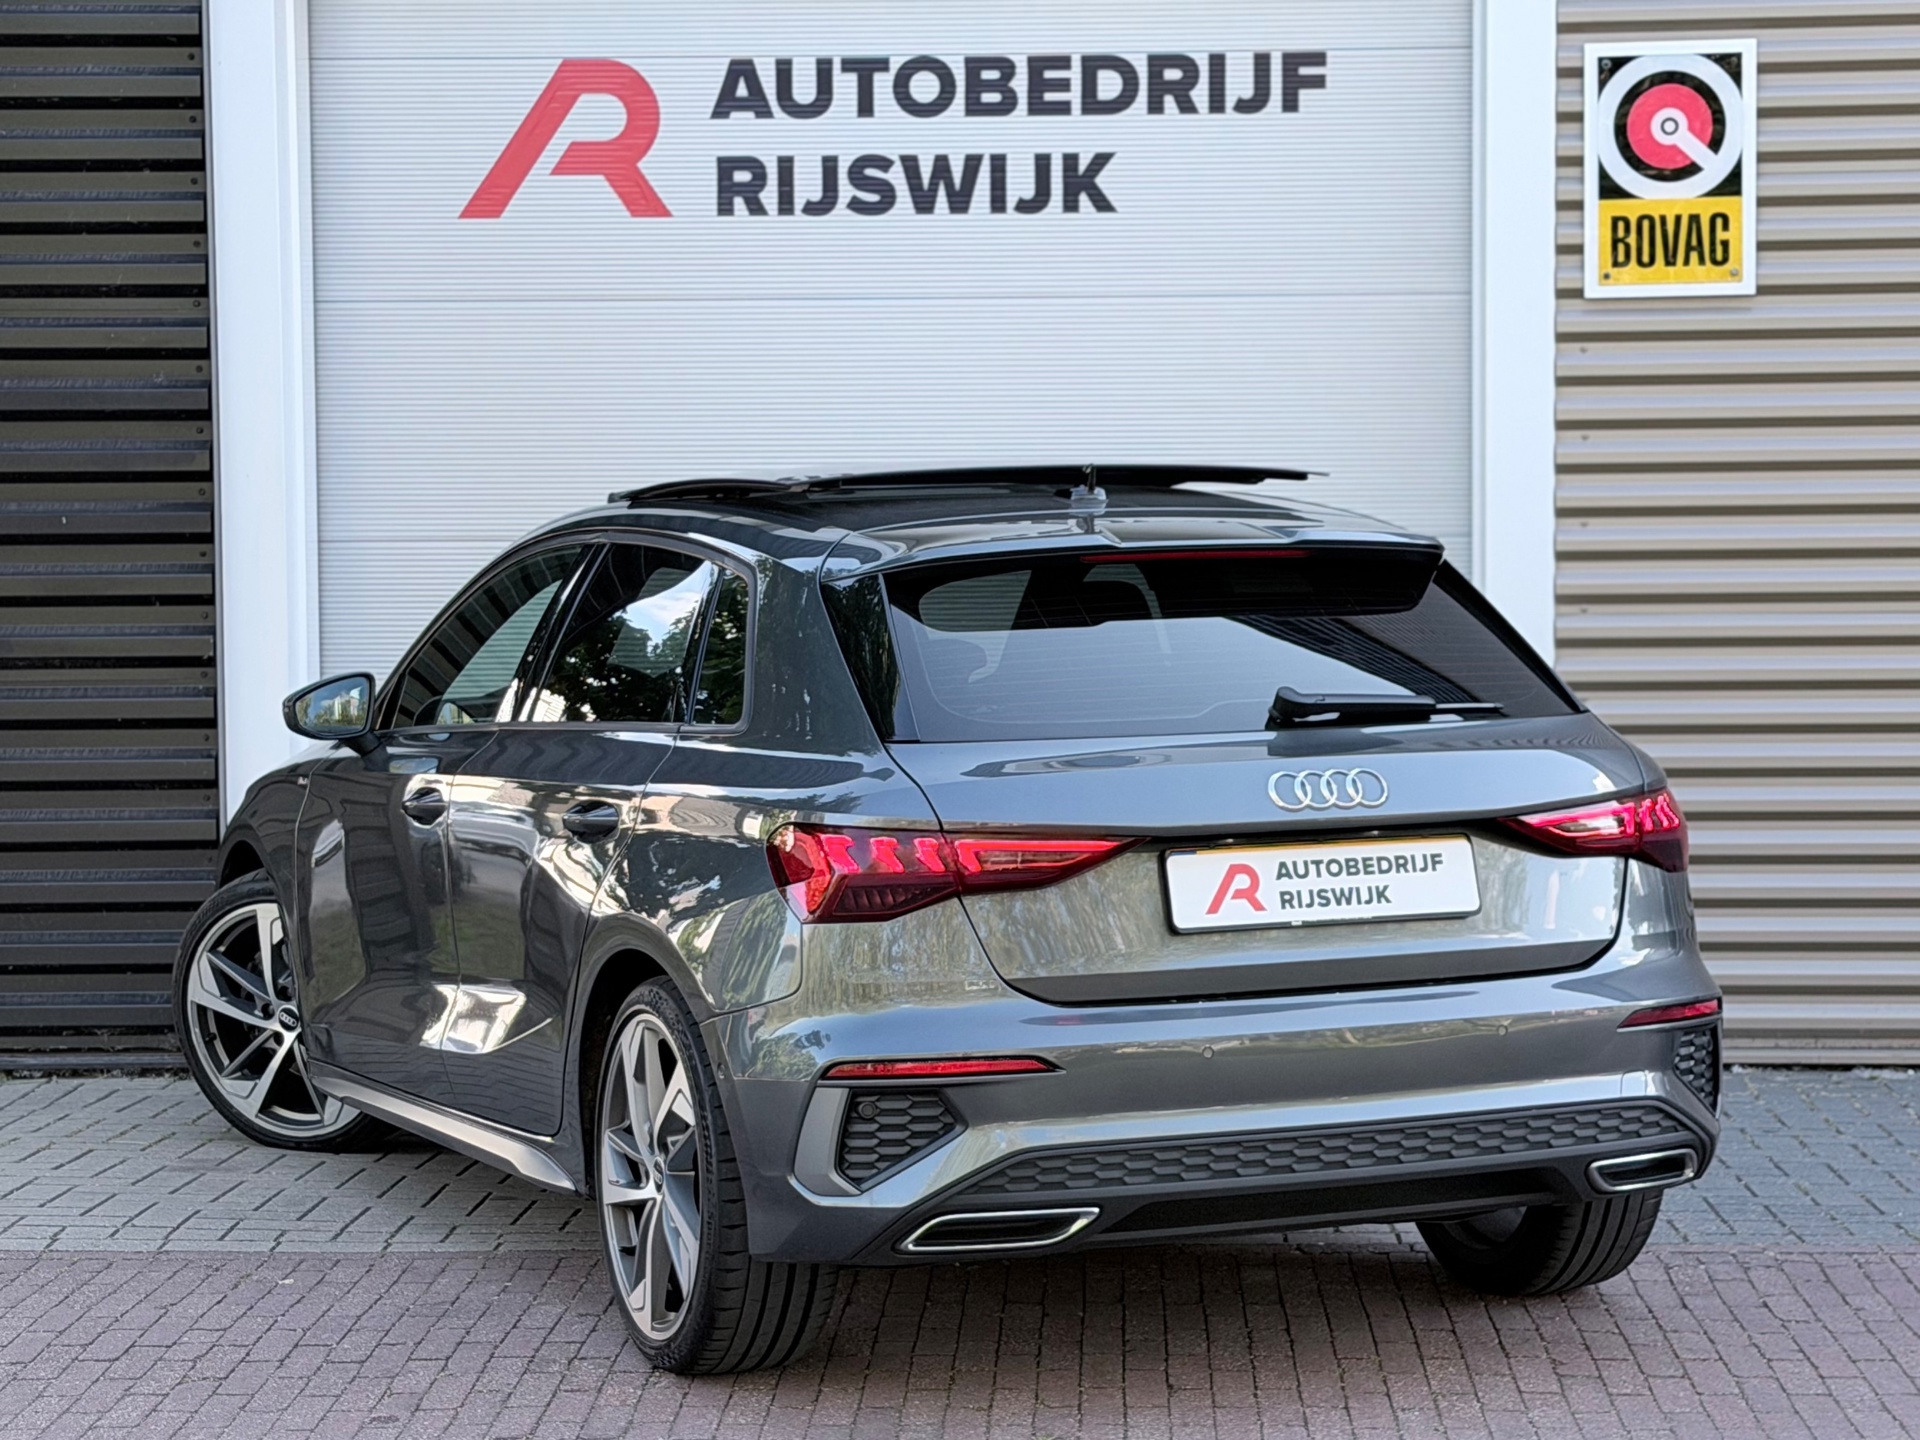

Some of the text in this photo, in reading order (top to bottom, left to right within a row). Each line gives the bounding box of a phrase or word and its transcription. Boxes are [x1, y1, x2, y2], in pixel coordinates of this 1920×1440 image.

[709, 51, 1327, 119] AUTOBEDRIJF
[716, 152, 1117, 217] RIJSWIJK
[1611, 211, 1730, 269] BOVAG
[1275, 852, 1443, 881] AUTOBEDRIJF
[1279, 884, 1391, 910] RIJSWIJK
